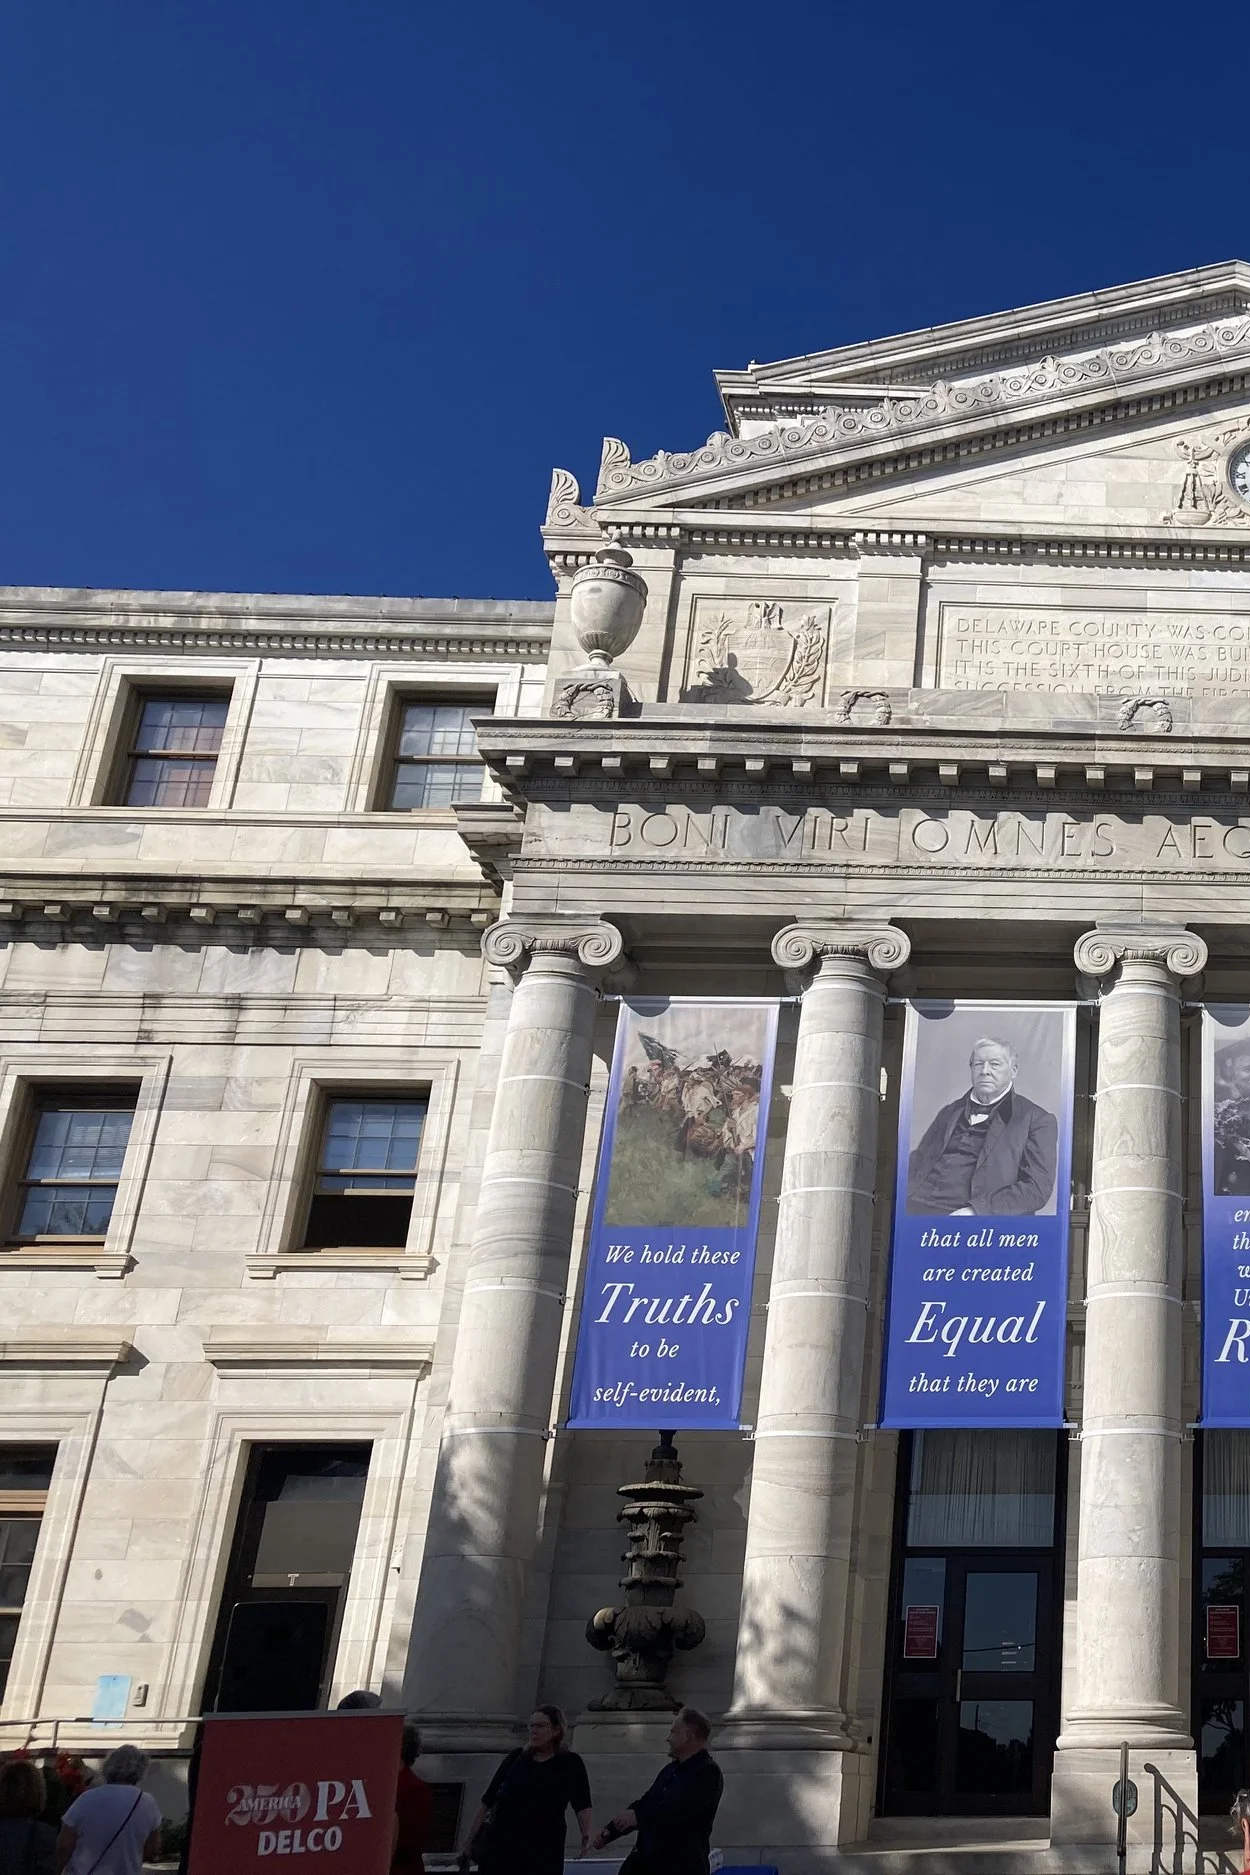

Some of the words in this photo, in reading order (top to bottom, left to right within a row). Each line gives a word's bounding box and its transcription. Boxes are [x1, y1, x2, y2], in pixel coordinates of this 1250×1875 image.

[957, 618, 1060, 636] DELAWARE
[1069, 621, 1156, 639] COUNTY
[1167, 624, 1205, 640] WAS
[956, 639, 1001, 655] THIS
[1010, 641, 1090, 660] COURT
[1094, 644, 1163, 660] HOUSE
[1169, 646, 1208, 661] WAS
[954, 660, 972, 675] IT
[978, 661, 995, 676] IS
[1003, 661, 1041, 677] THE
[1048, 663, 1109, 679] SIXTH
[1118, 665, 1145, 680] OF
[1154, 666, 1196, 681] THIS
[610, 813, 730, 849] BONI
[775, 815, 871, 850] VIRI
[912, 818, 1116, 857] OMNES
[920, 1229, 961, 1248] that
[966, 1229, 994, 1248] all
[999, 1233, 1039, 1248] men
[605, 1245, 634, 1264] We
[640, 1244, 687, 1264] hold
[691, 1245, 741, 1265] these
[923, 1267, 956, 1281] are
[961, 1263, 1035, 1282] created
[594, 1282, 740, 1325] Truths
[904, 1300, 1047, 1357] Equal
[630, 1341, 650, 1358] to
[657, 1338, 680, 1358] be
[593, 1381, 721, 1407] self-evident,
[908, 1372, 951, 1393] that
[957, 1372, 999, 1398] they
[1005, 1378, 1039, 1393] are
[225, 1781, 311, 1826] 250
[313, 1779, 372, 1822] PA
[239, 1795, 302, 1811] AMERICA
[257, 1825, 343, 1856] DELCO
